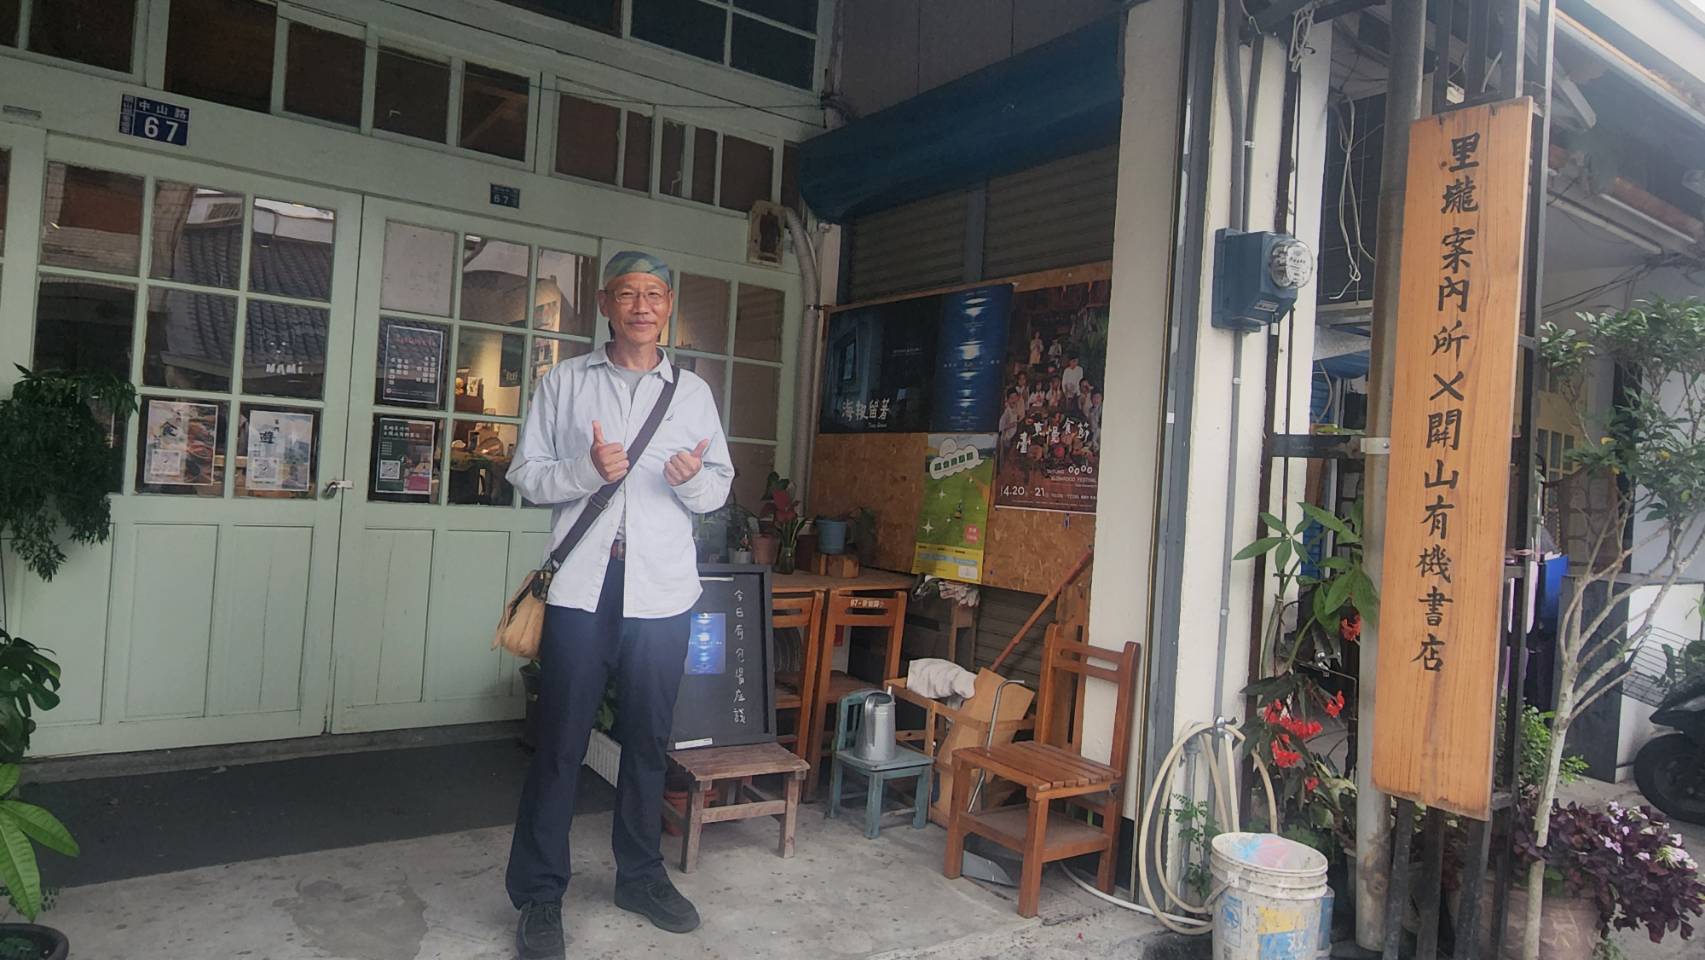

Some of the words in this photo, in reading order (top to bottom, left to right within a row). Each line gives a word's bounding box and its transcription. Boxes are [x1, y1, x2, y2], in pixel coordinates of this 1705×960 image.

[138, 100, 186, 120] 中山路
[144, 116, 179, 142] 67
[494, 194, 509, 204] 67
[1003, 486, 1025, 497] 4.20
[1034, 487, 1045, 497] 21
